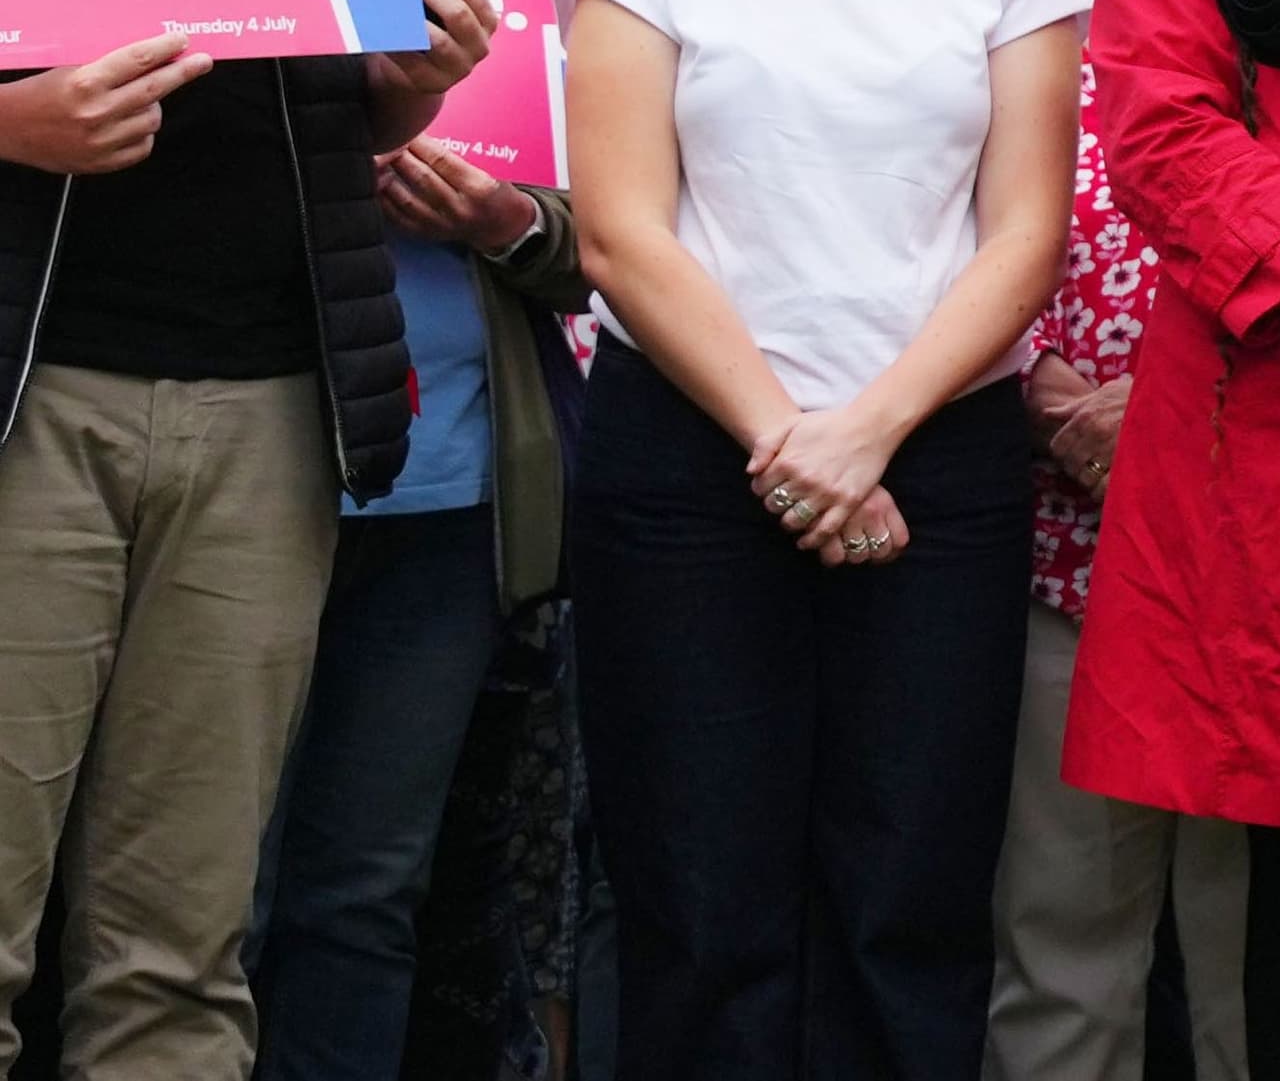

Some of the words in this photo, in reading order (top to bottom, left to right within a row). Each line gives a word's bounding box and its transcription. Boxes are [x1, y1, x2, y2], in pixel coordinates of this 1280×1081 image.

[161, 19, 244, 37] Thursday
[247, 16, 258, 31] 4
[262, 15, 297, 35] July
[472, 141, 484, 155] 4
[485, 143, 519, 164] July
